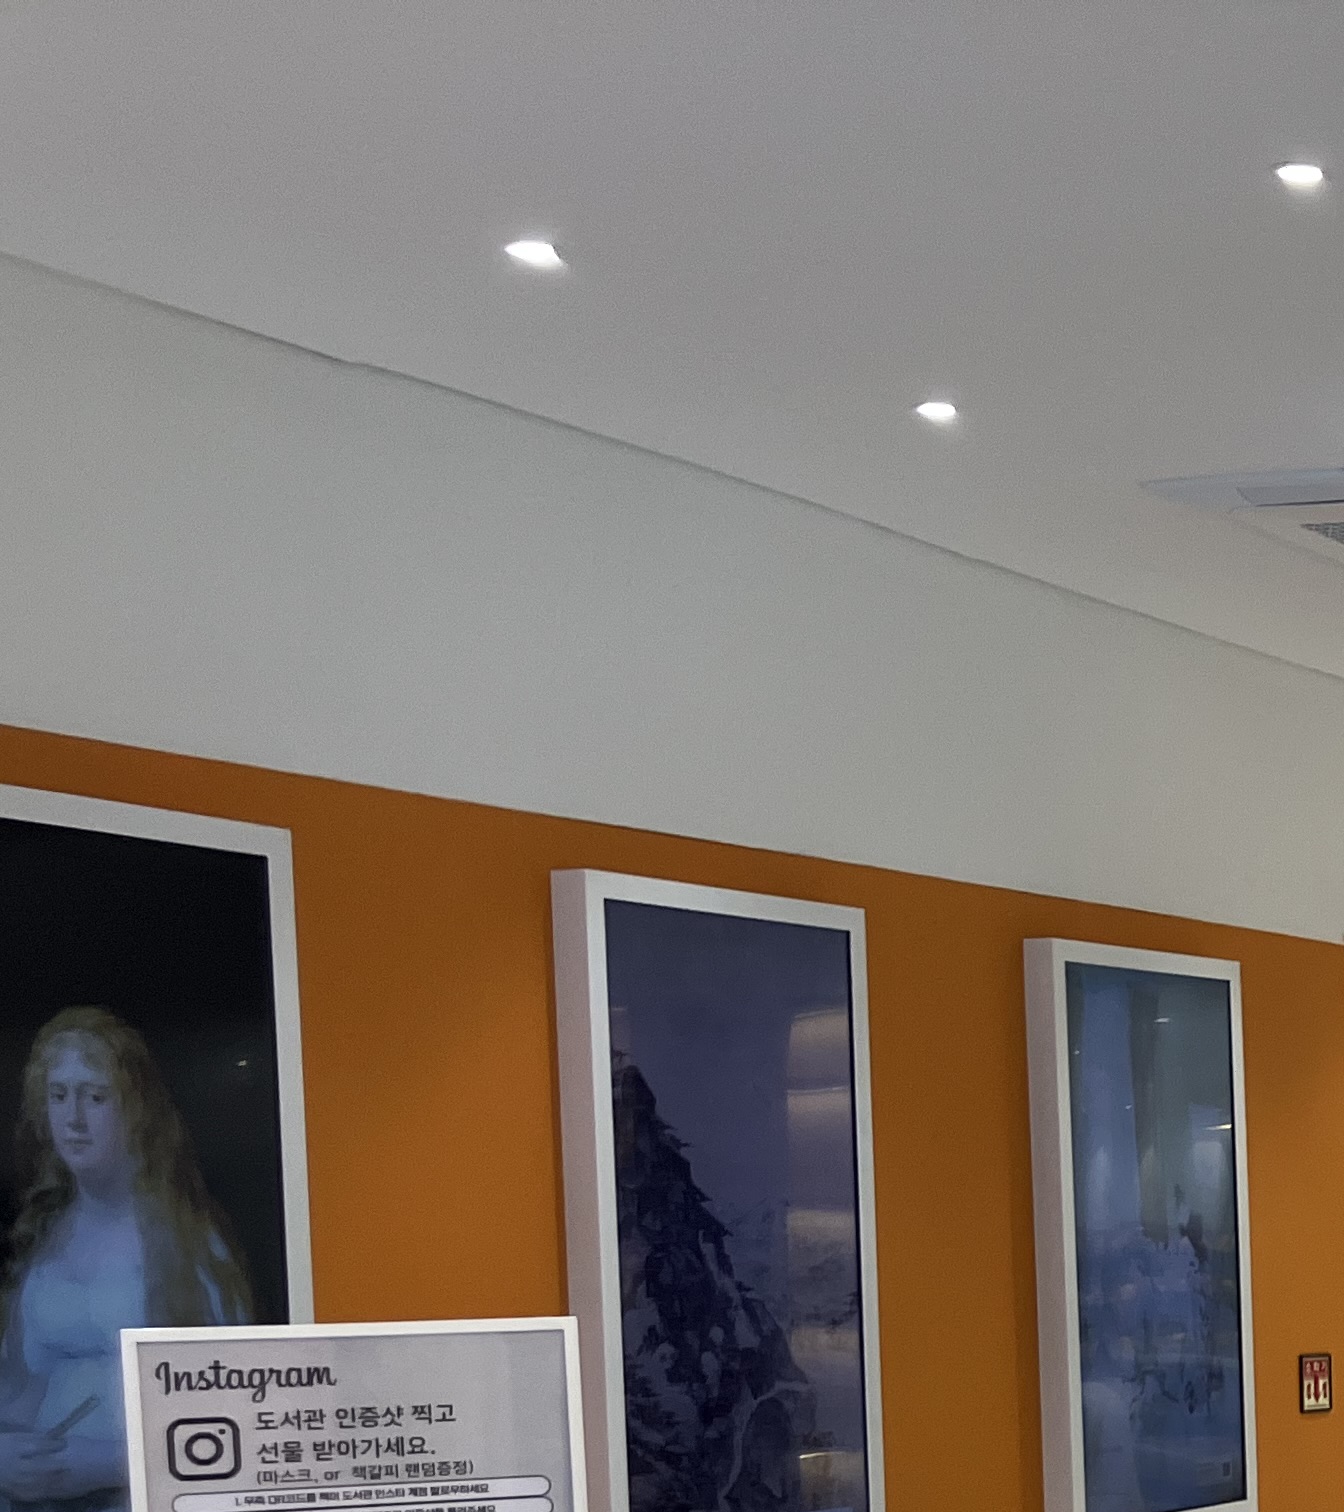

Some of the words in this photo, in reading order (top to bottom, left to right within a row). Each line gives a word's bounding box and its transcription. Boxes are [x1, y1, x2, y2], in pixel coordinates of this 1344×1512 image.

[155, 1360, 337, 1403] Instagram
[255, 1408, 326, 1431] 도서관
[335, 1405, 405, 1430] 인증샷
[411, 1404, 457, 1425] 찍고
[256, 1441, 304, 1464] 선물
[312, 1436, 436, 1462] 받아가세요.
[256, 1469, 319, 1485] (마스크,
[324, 1471, 340, 1481] or
[352, 1465, 399, 1480] 책갈피
